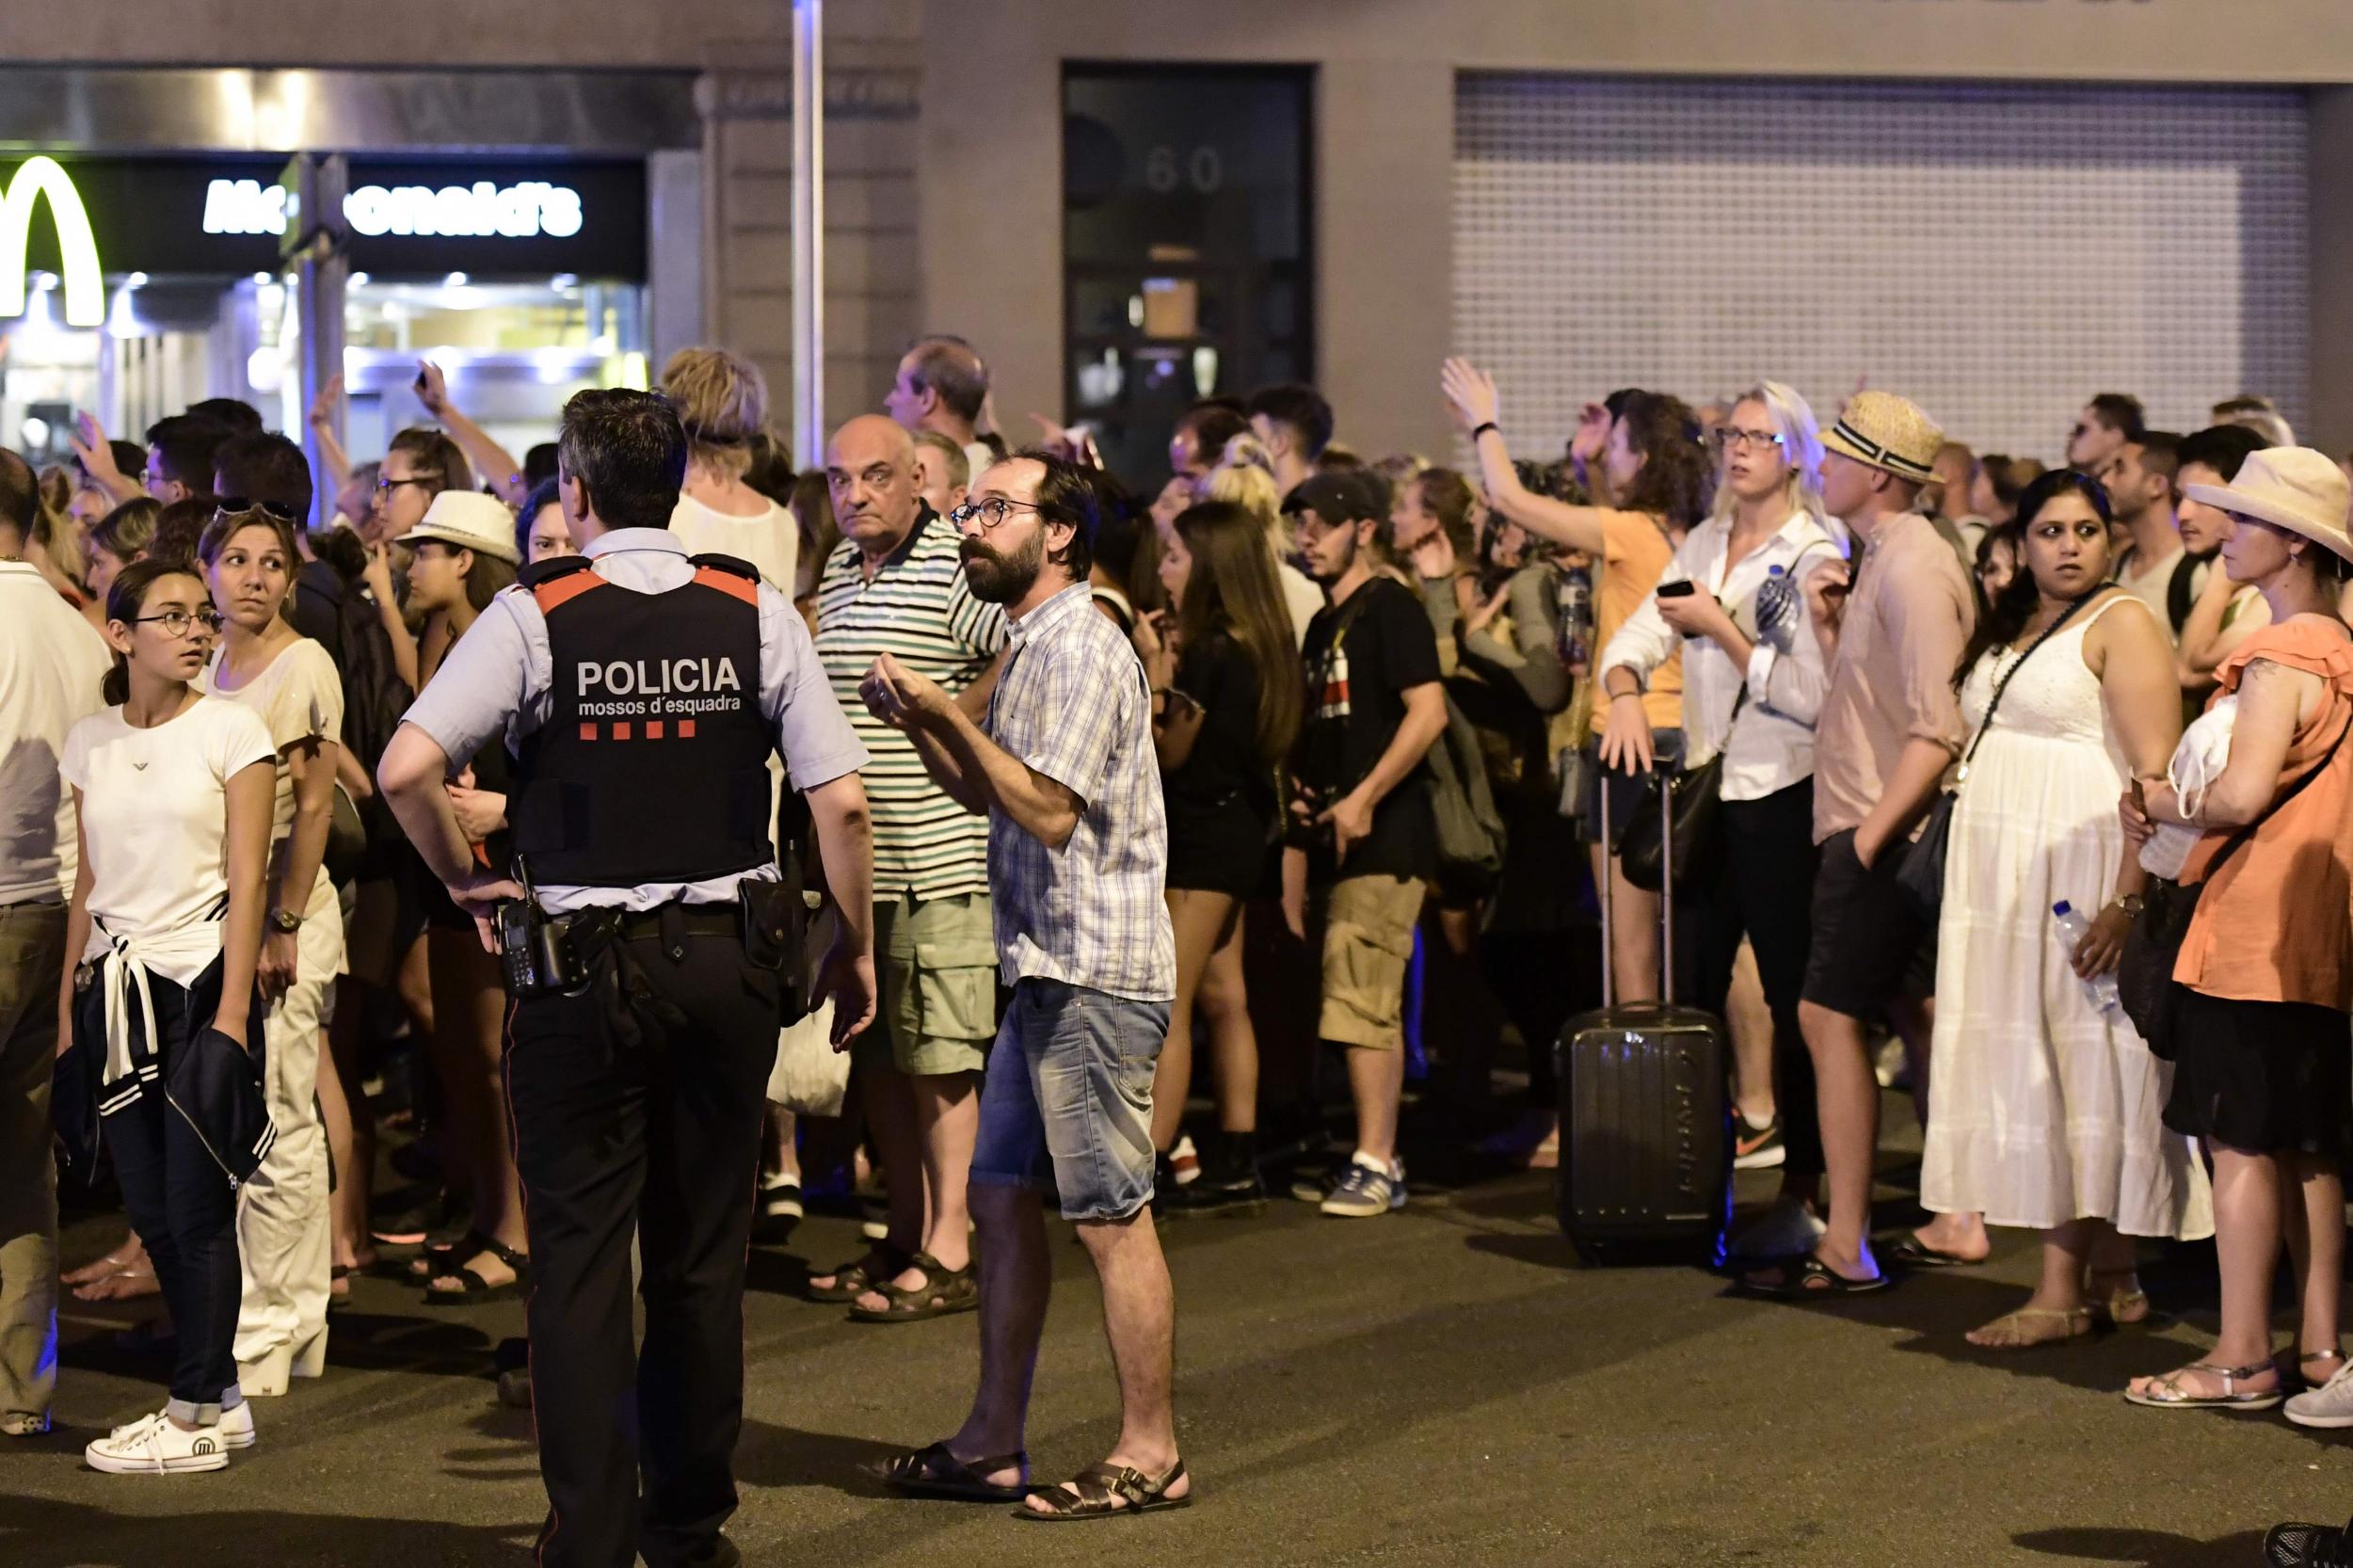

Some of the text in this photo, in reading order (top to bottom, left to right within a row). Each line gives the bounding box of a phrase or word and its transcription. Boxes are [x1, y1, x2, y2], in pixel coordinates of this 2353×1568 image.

[202, 179, 583, 237] Mconald's
[577, 657, 741, 696] POLICIA
[579, 702, 646, 715] mossos
